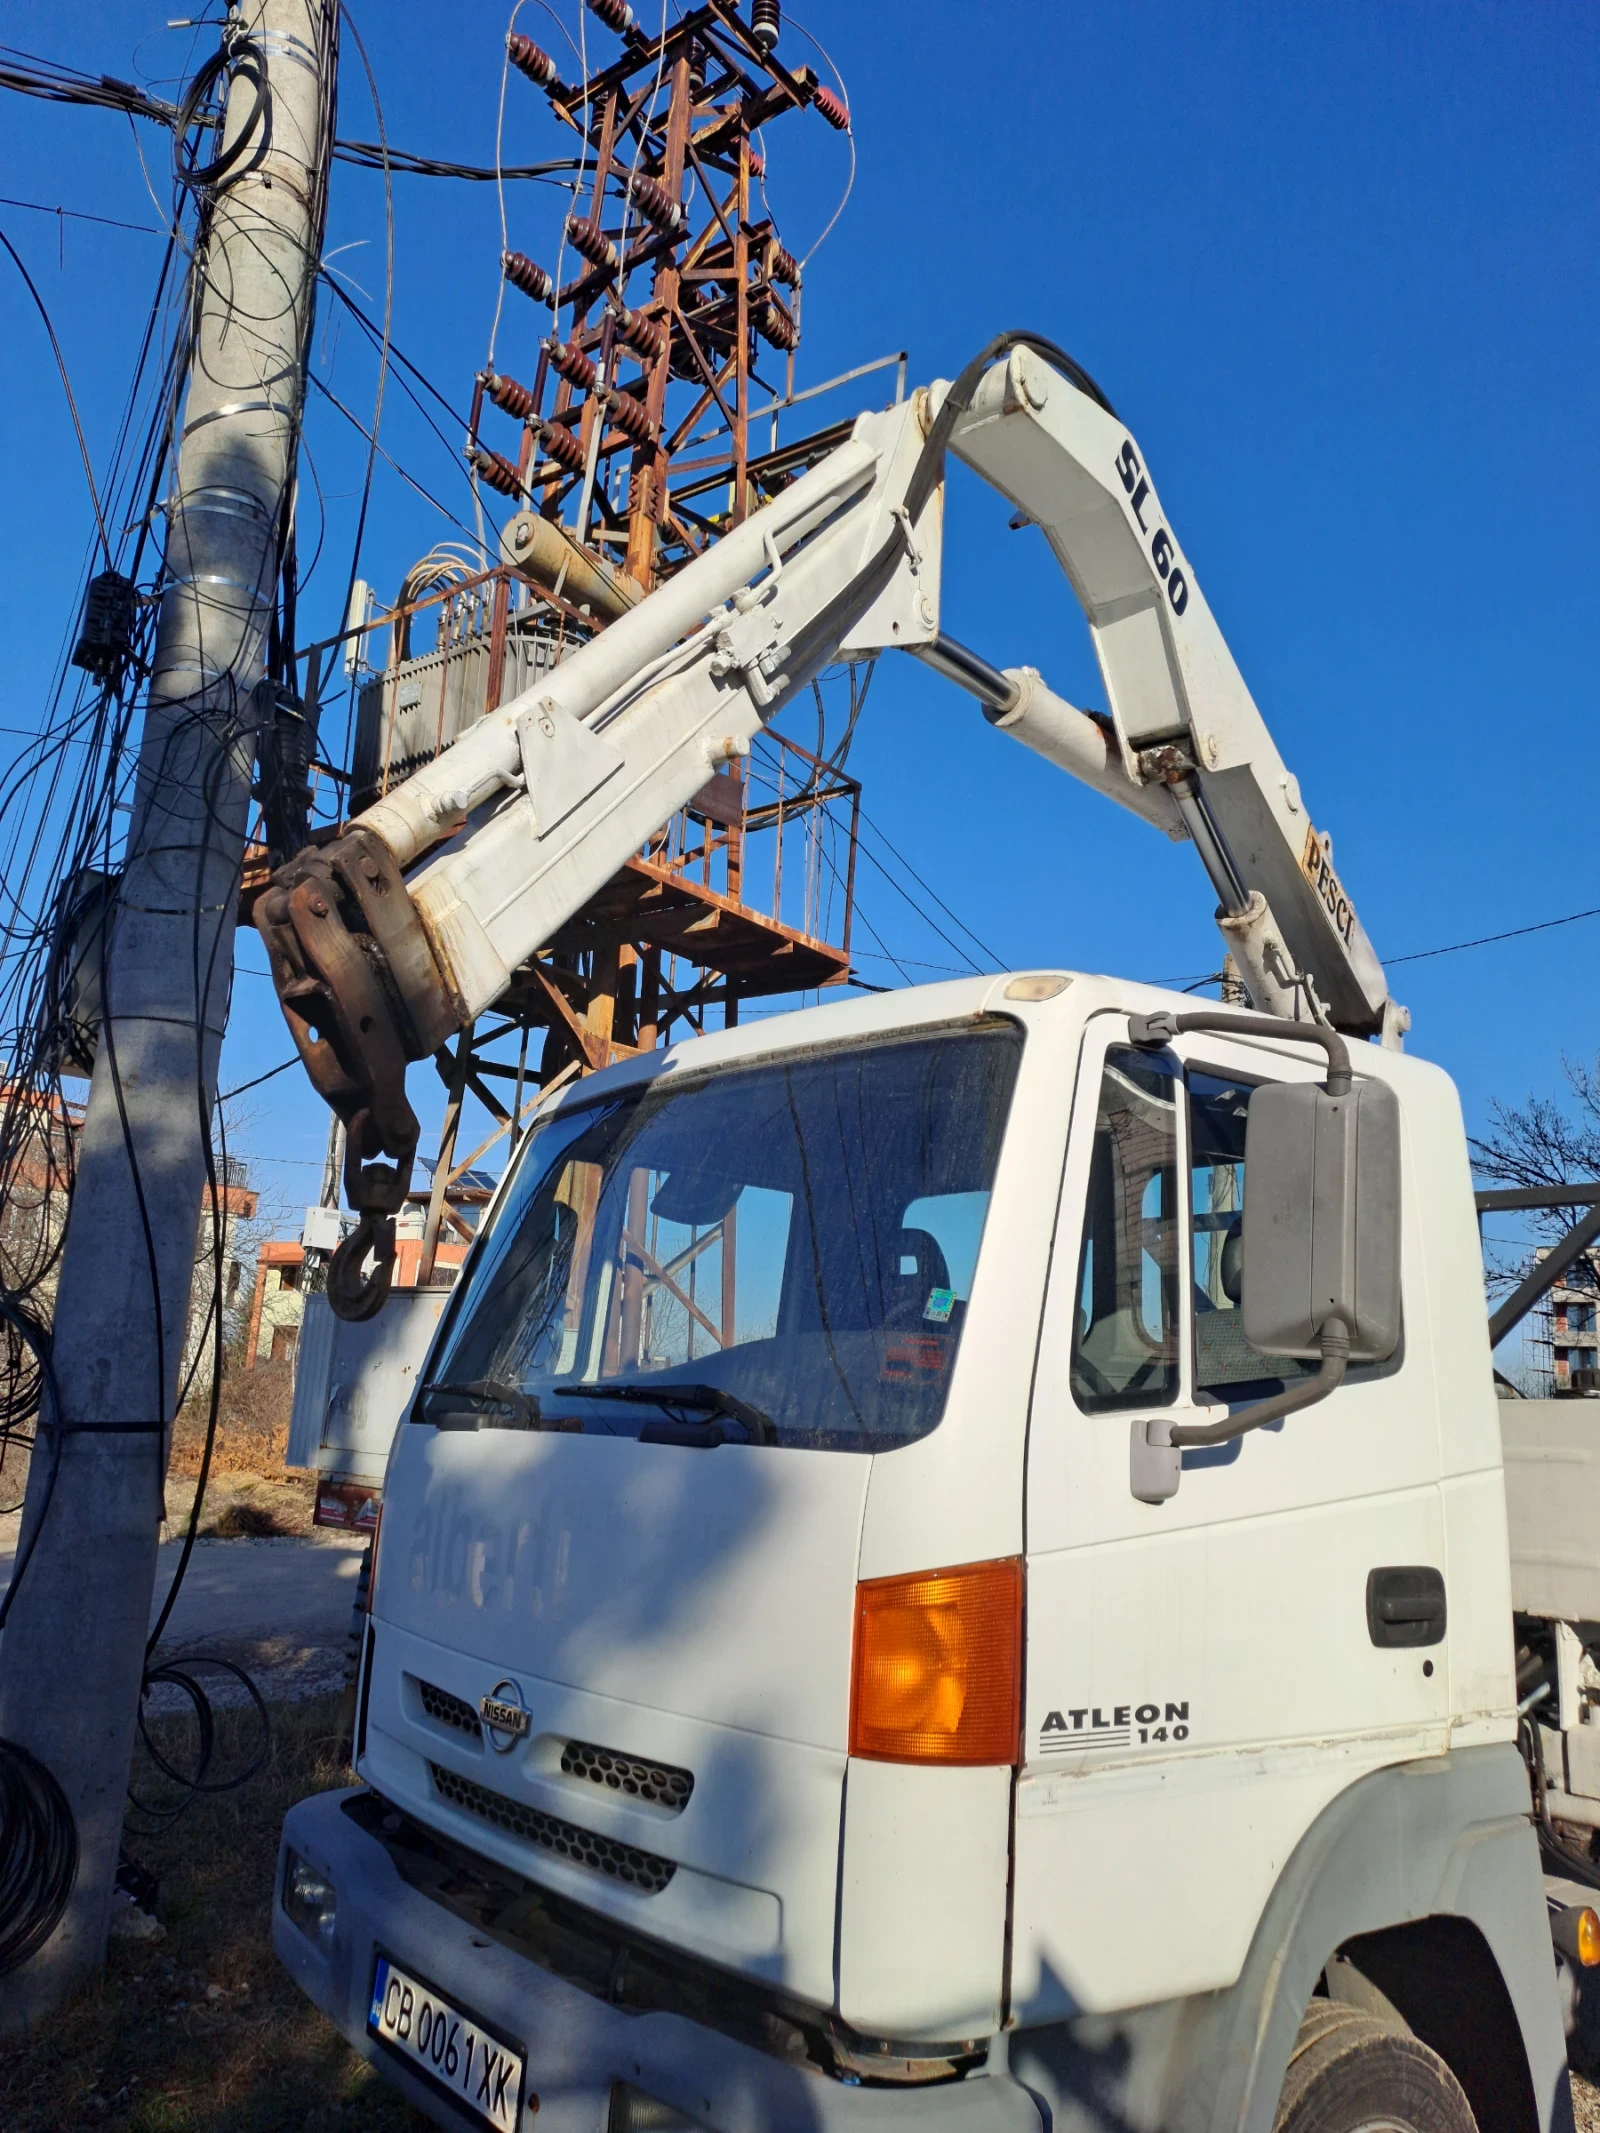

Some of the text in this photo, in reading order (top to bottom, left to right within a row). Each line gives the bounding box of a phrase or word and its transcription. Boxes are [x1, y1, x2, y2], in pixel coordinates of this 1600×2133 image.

[1114, 439, 1189, 617] SL 60
[1307, 837, 1355, 946] PESCI
[483, 1702, 521, 1730] NISSAN
[1040, 1701, 1189, 1733] ATLEON
[1138, 1724, 1189, 1744] 140
[384, 1976, 516, 2122] CB 0061 XK
